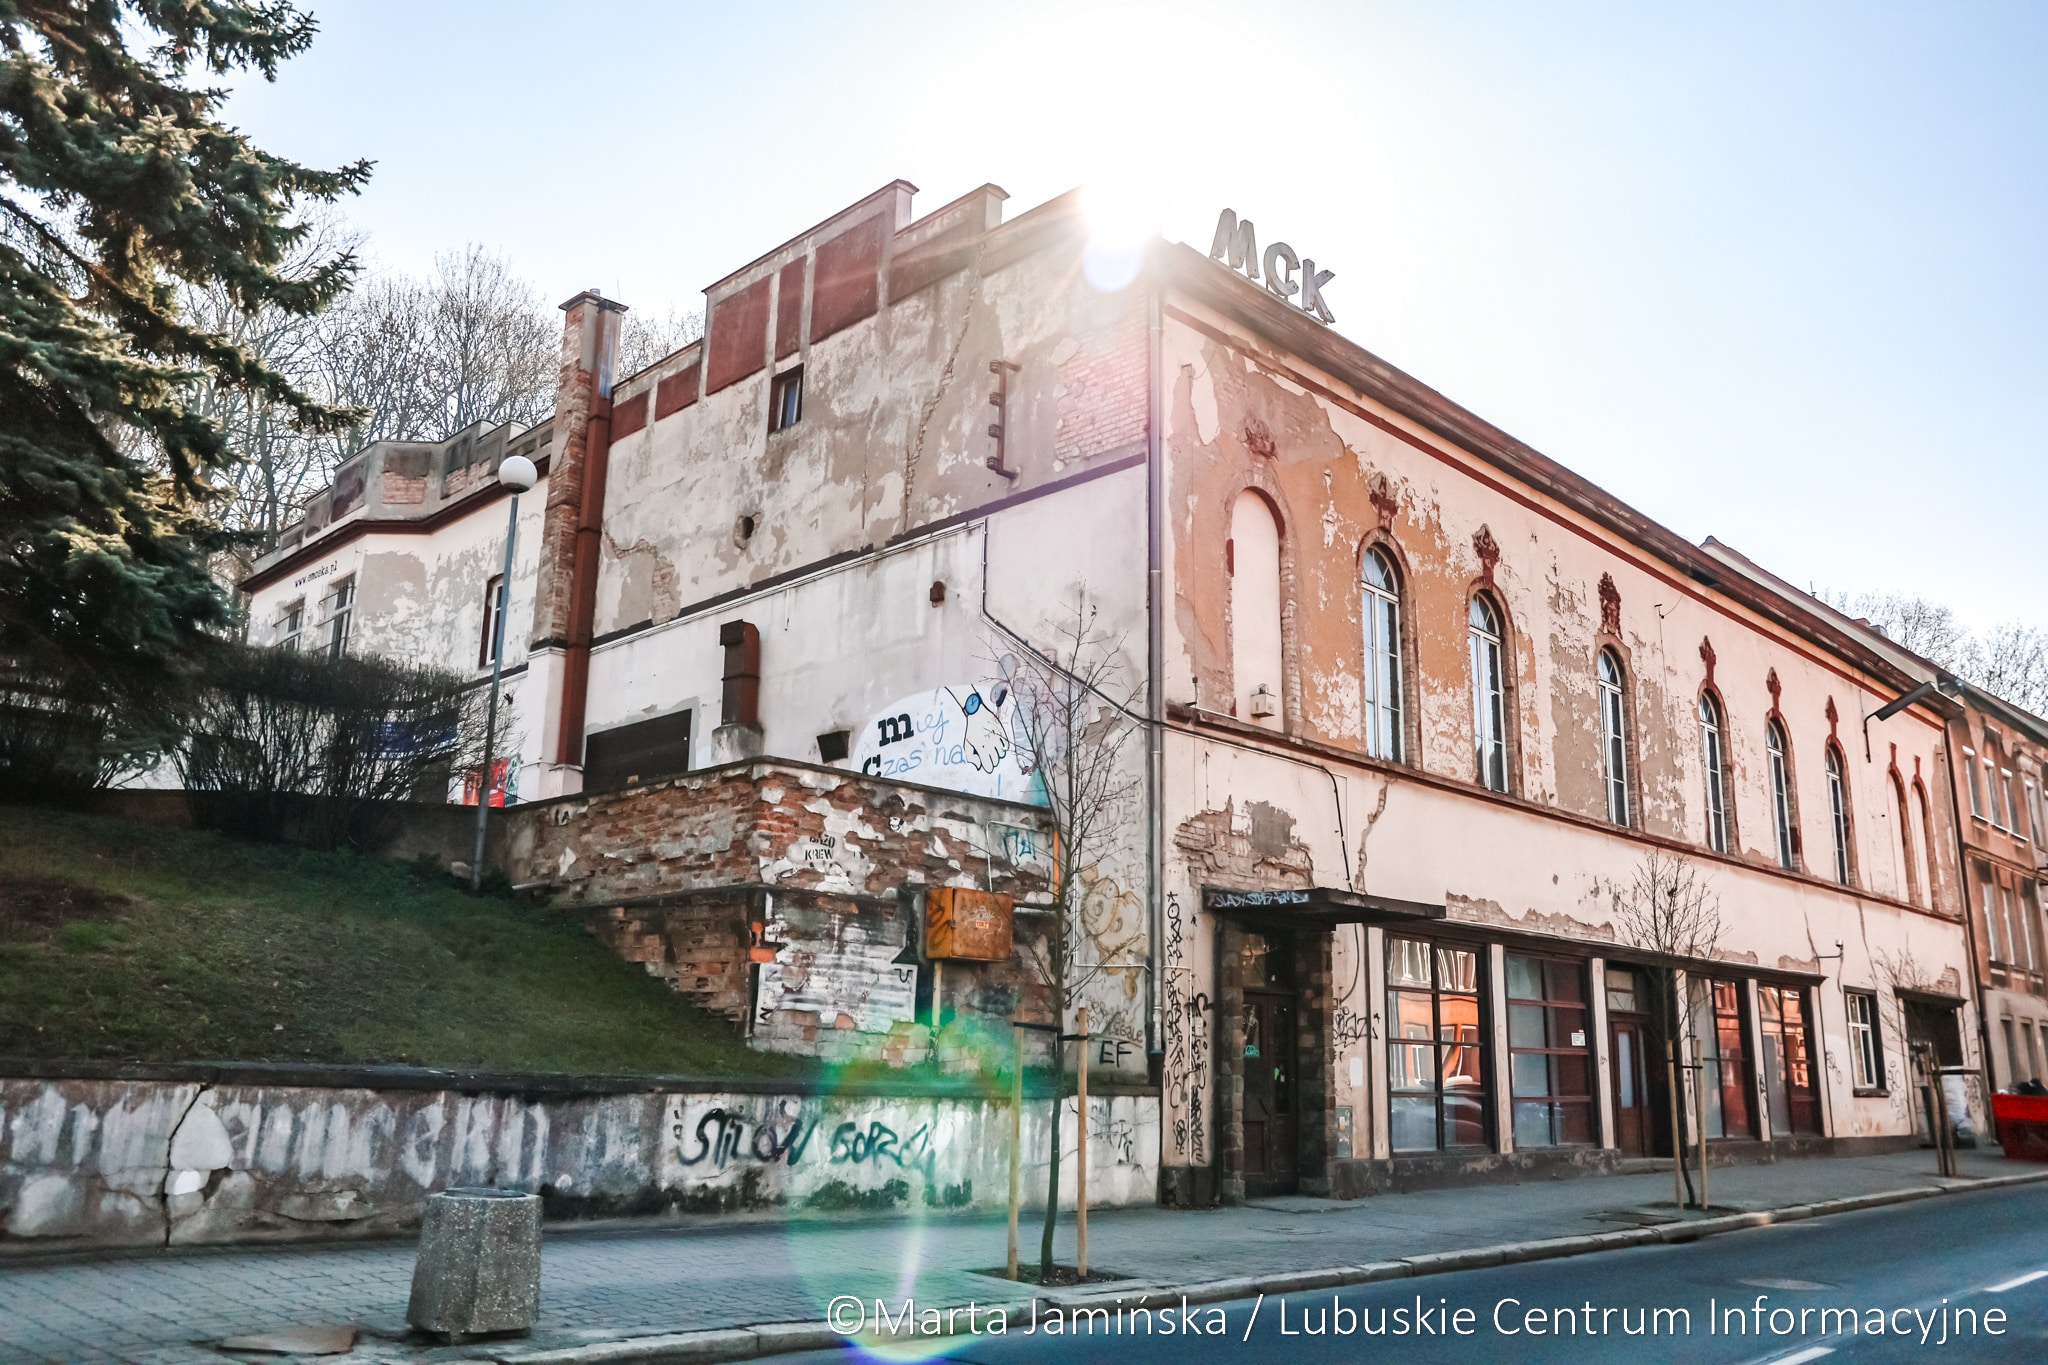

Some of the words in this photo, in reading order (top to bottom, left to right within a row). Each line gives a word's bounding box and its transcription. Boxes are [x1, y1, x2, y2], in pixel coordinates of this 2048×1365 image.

[1209, 207, 1336, 324] MCK
[877, 701, 950, 748] miej
[934, 743, 967, 766] na
[804, 848, 834, 861] KREW
[1100, 1040, 1133, 1069] EF
